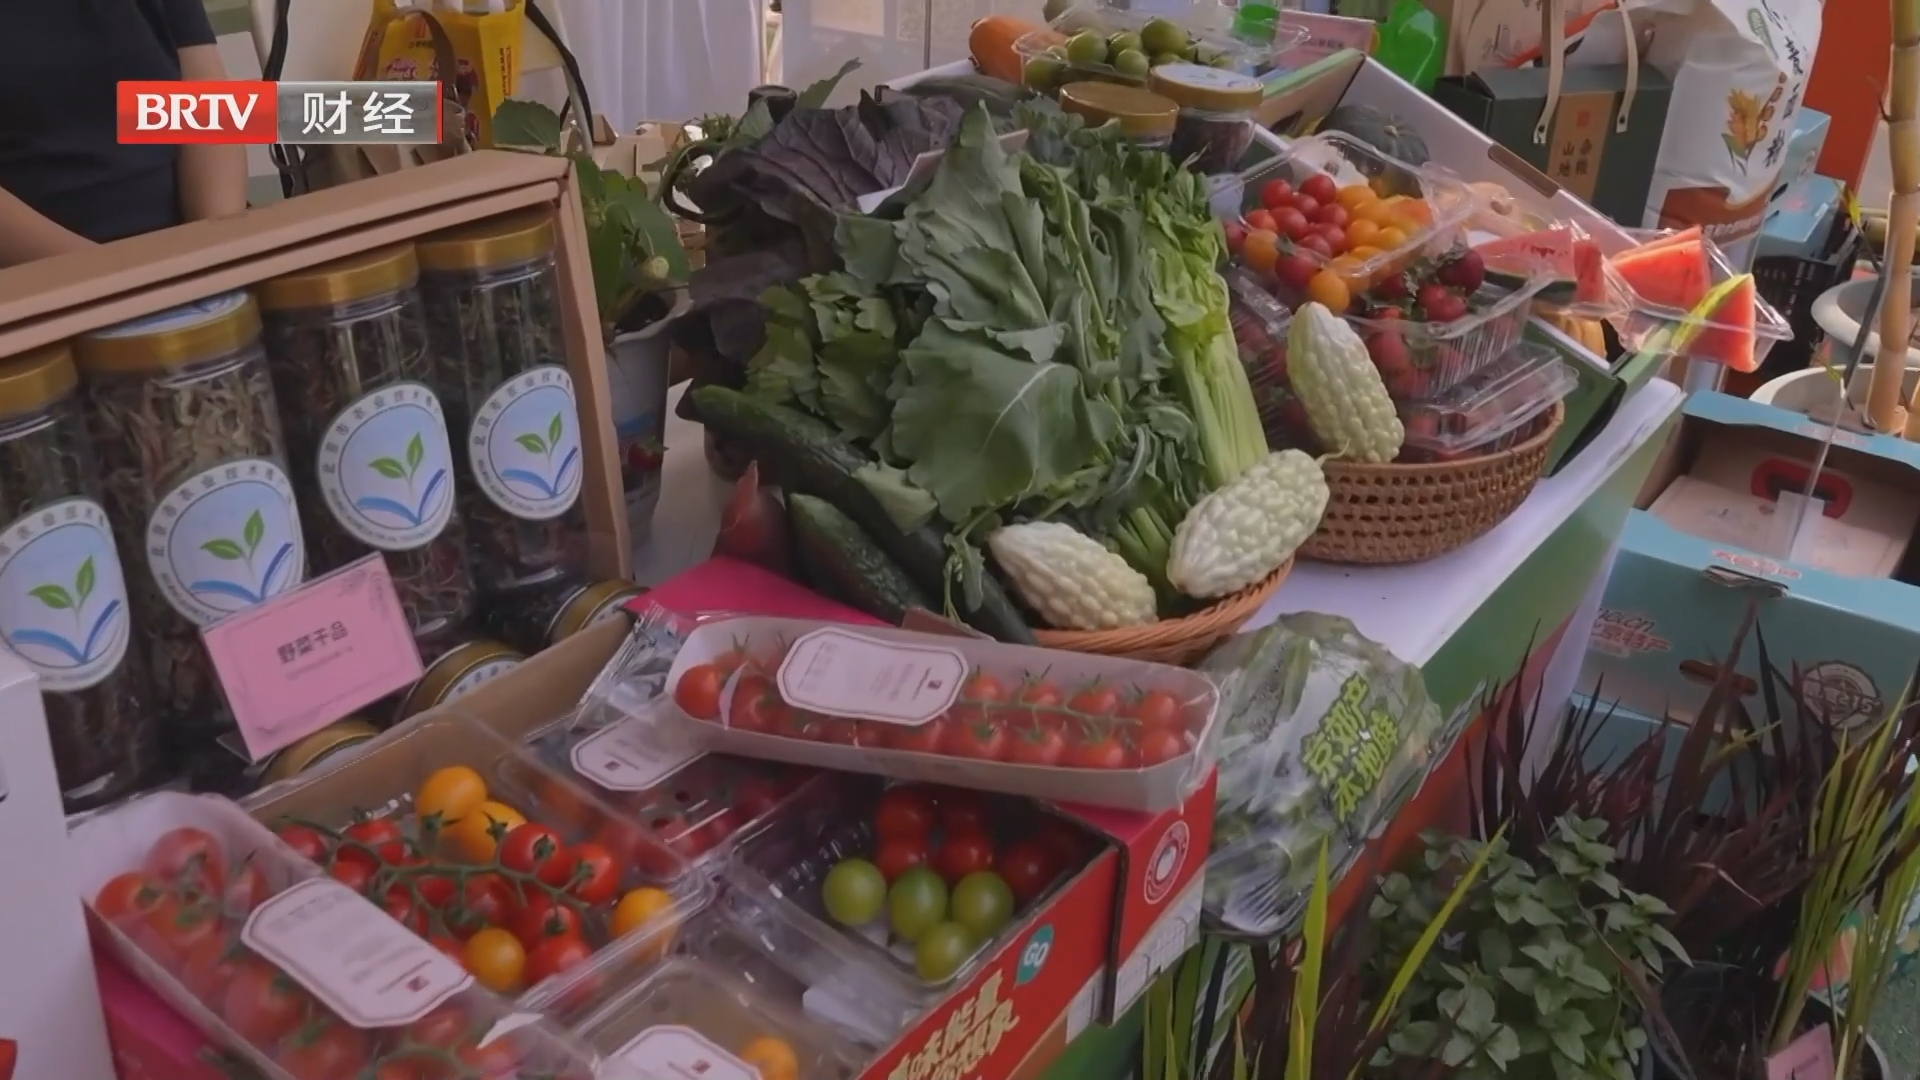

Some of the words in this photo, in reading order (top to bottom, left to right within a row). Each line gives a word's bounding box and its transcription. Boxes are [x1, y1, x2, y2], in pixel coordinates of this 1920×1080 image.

[1302, 673, 1368, 788] 京郊产
[1023, 940, 1050, 968] GO
